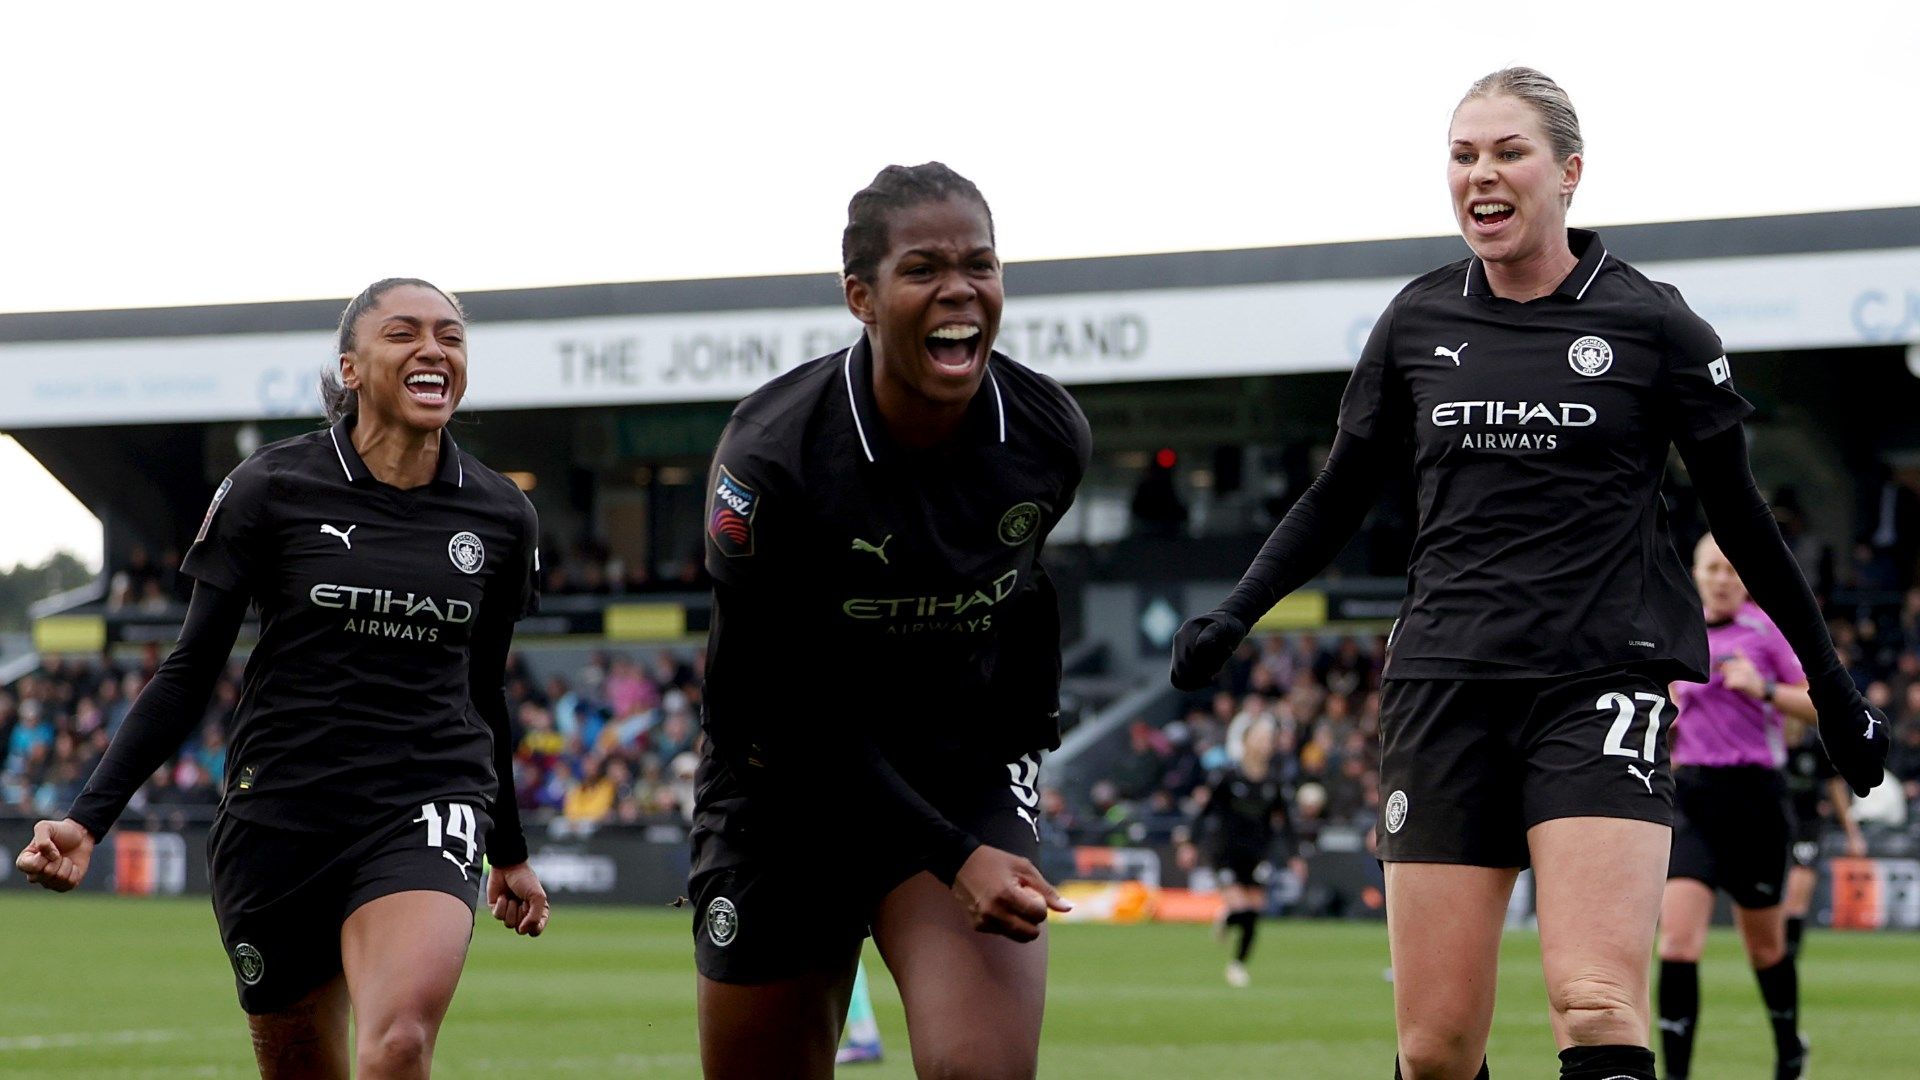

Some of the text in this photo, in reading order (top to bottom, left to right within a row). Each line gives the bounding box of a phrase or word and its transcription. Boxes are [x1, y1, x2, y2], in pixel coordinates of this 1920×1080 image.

[556, 338, 642, 386] THE
[658, 330, 784, 384] JOHN
[997, 312, 1148, 364] STAND
[1431, 400, 1597, 427] ETIHAD
[1461, 433, 1558, 450] AIRWAYS
[309, 583, 473, 624] ETIHAD
[842, 568, 1018, 619] ETIHAD
[344, 617, 440, 643] AIRWAYS
[885, 614, 992, 635] AIRWAYS
[1595, 691, 1666, 764] 27
[412, 802, 478, 863] 14
